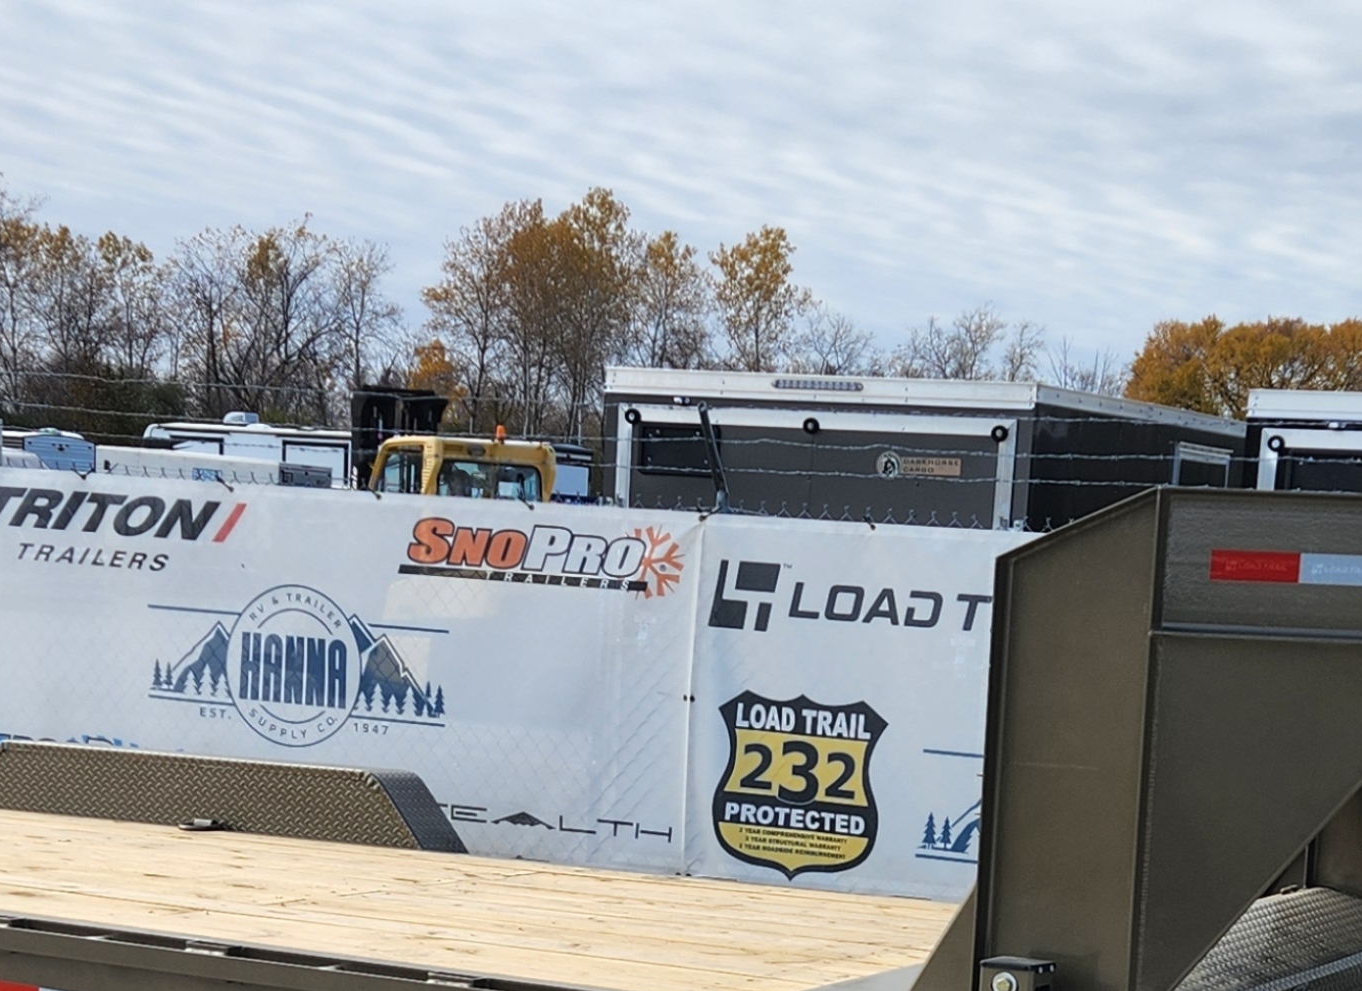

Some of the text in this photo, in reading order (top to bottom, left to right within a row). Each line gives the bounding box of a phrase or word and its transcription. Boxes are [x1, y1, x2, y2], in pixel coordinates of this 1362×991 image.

[17, 542, 170, 572] TRAILERS
[487, 571, 630, 592] TRAILERS
[248, 592, 342, 629] RV & TRAILER
[788, 582, 944, 628] LOAD
[239, 631, 347, 709] HANNA
[200, 706, 232, 719] EST.
[248, 708, 307, 739] SUPPLY
[735, 702, 872, 740] LOAD TRAIL
[353, 722, 389, 735] 1947
[740, 740, 856, 805] 232
[724, 801, 866, 835] PROTECTED
[762, 845, 794, 854] ROADSIDE
[809, 842, 841, 851] WARRANTY
[816, 835, 848, 844] WARRANTY
